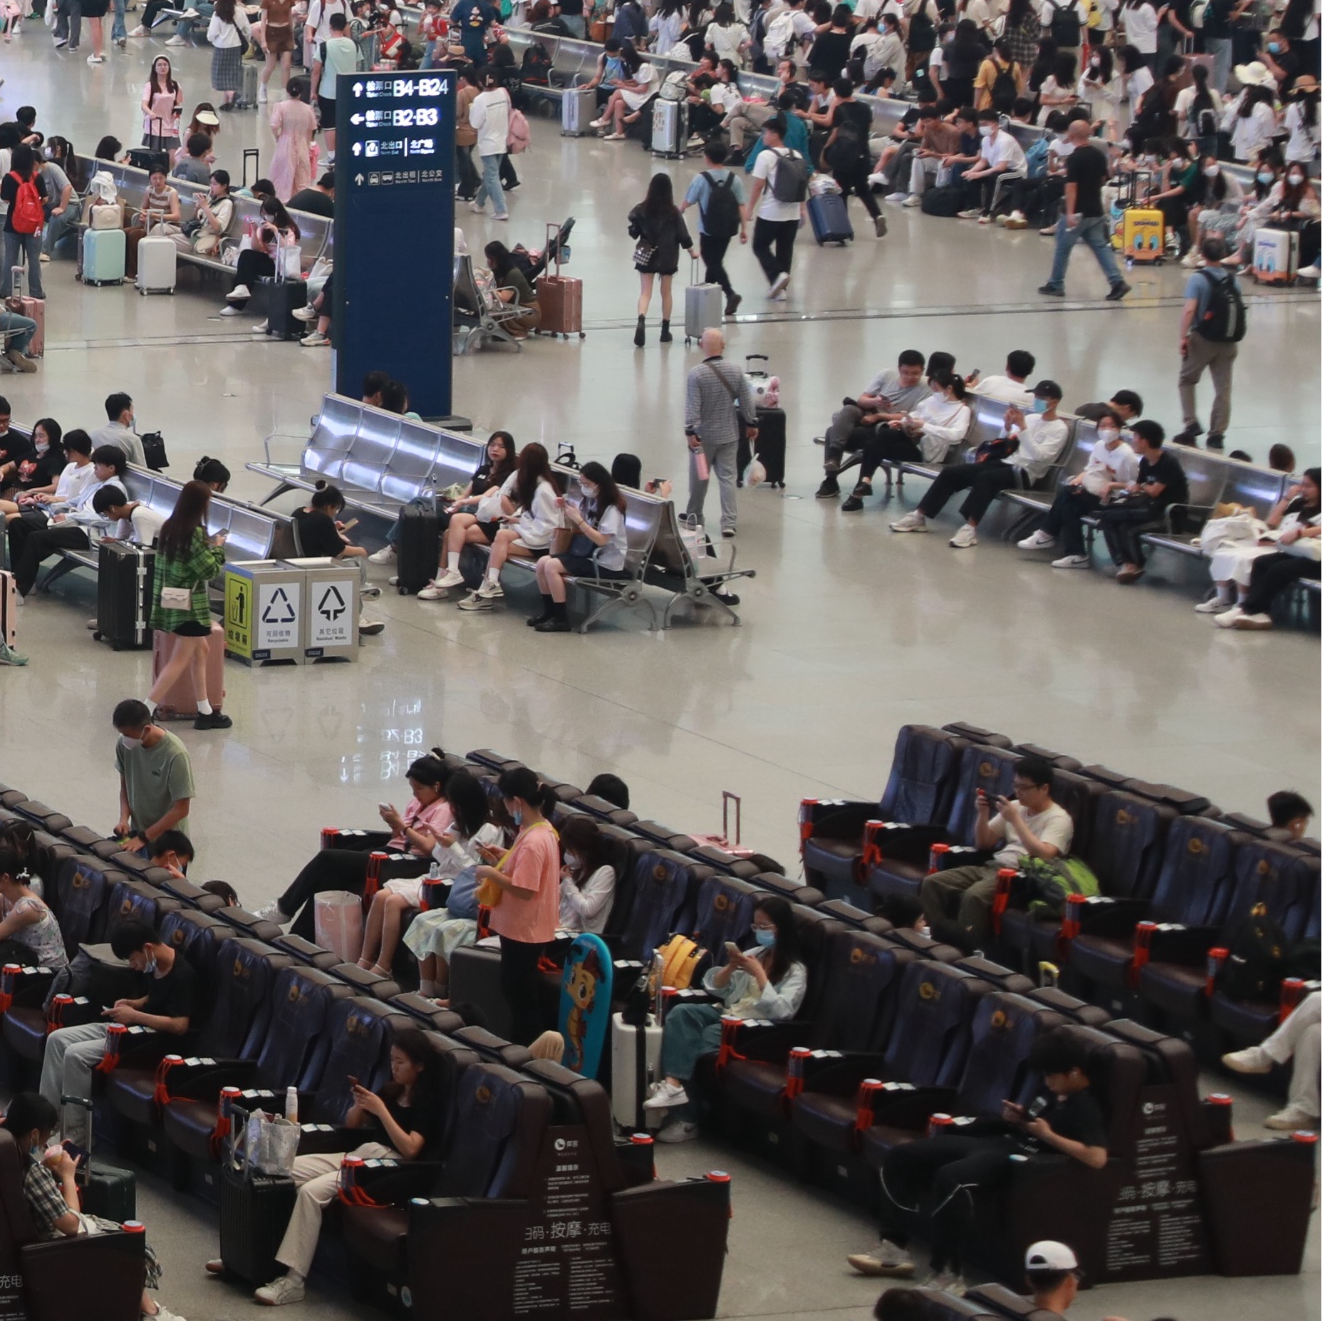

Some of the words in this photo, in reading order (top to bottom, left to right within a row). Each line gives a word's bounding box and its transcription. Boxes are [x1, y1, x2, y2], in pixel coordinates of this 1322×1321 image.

[392, 78, 449, 98] B4-B24
[381, 141, 403, 150] 北出口
[395, 171, 416, 179] 北出租
[421, 169, 443, 178] 北公交
[266, 630, 291, 638] 可回收物
[319, 627, 344, 635] 其它垃圾
